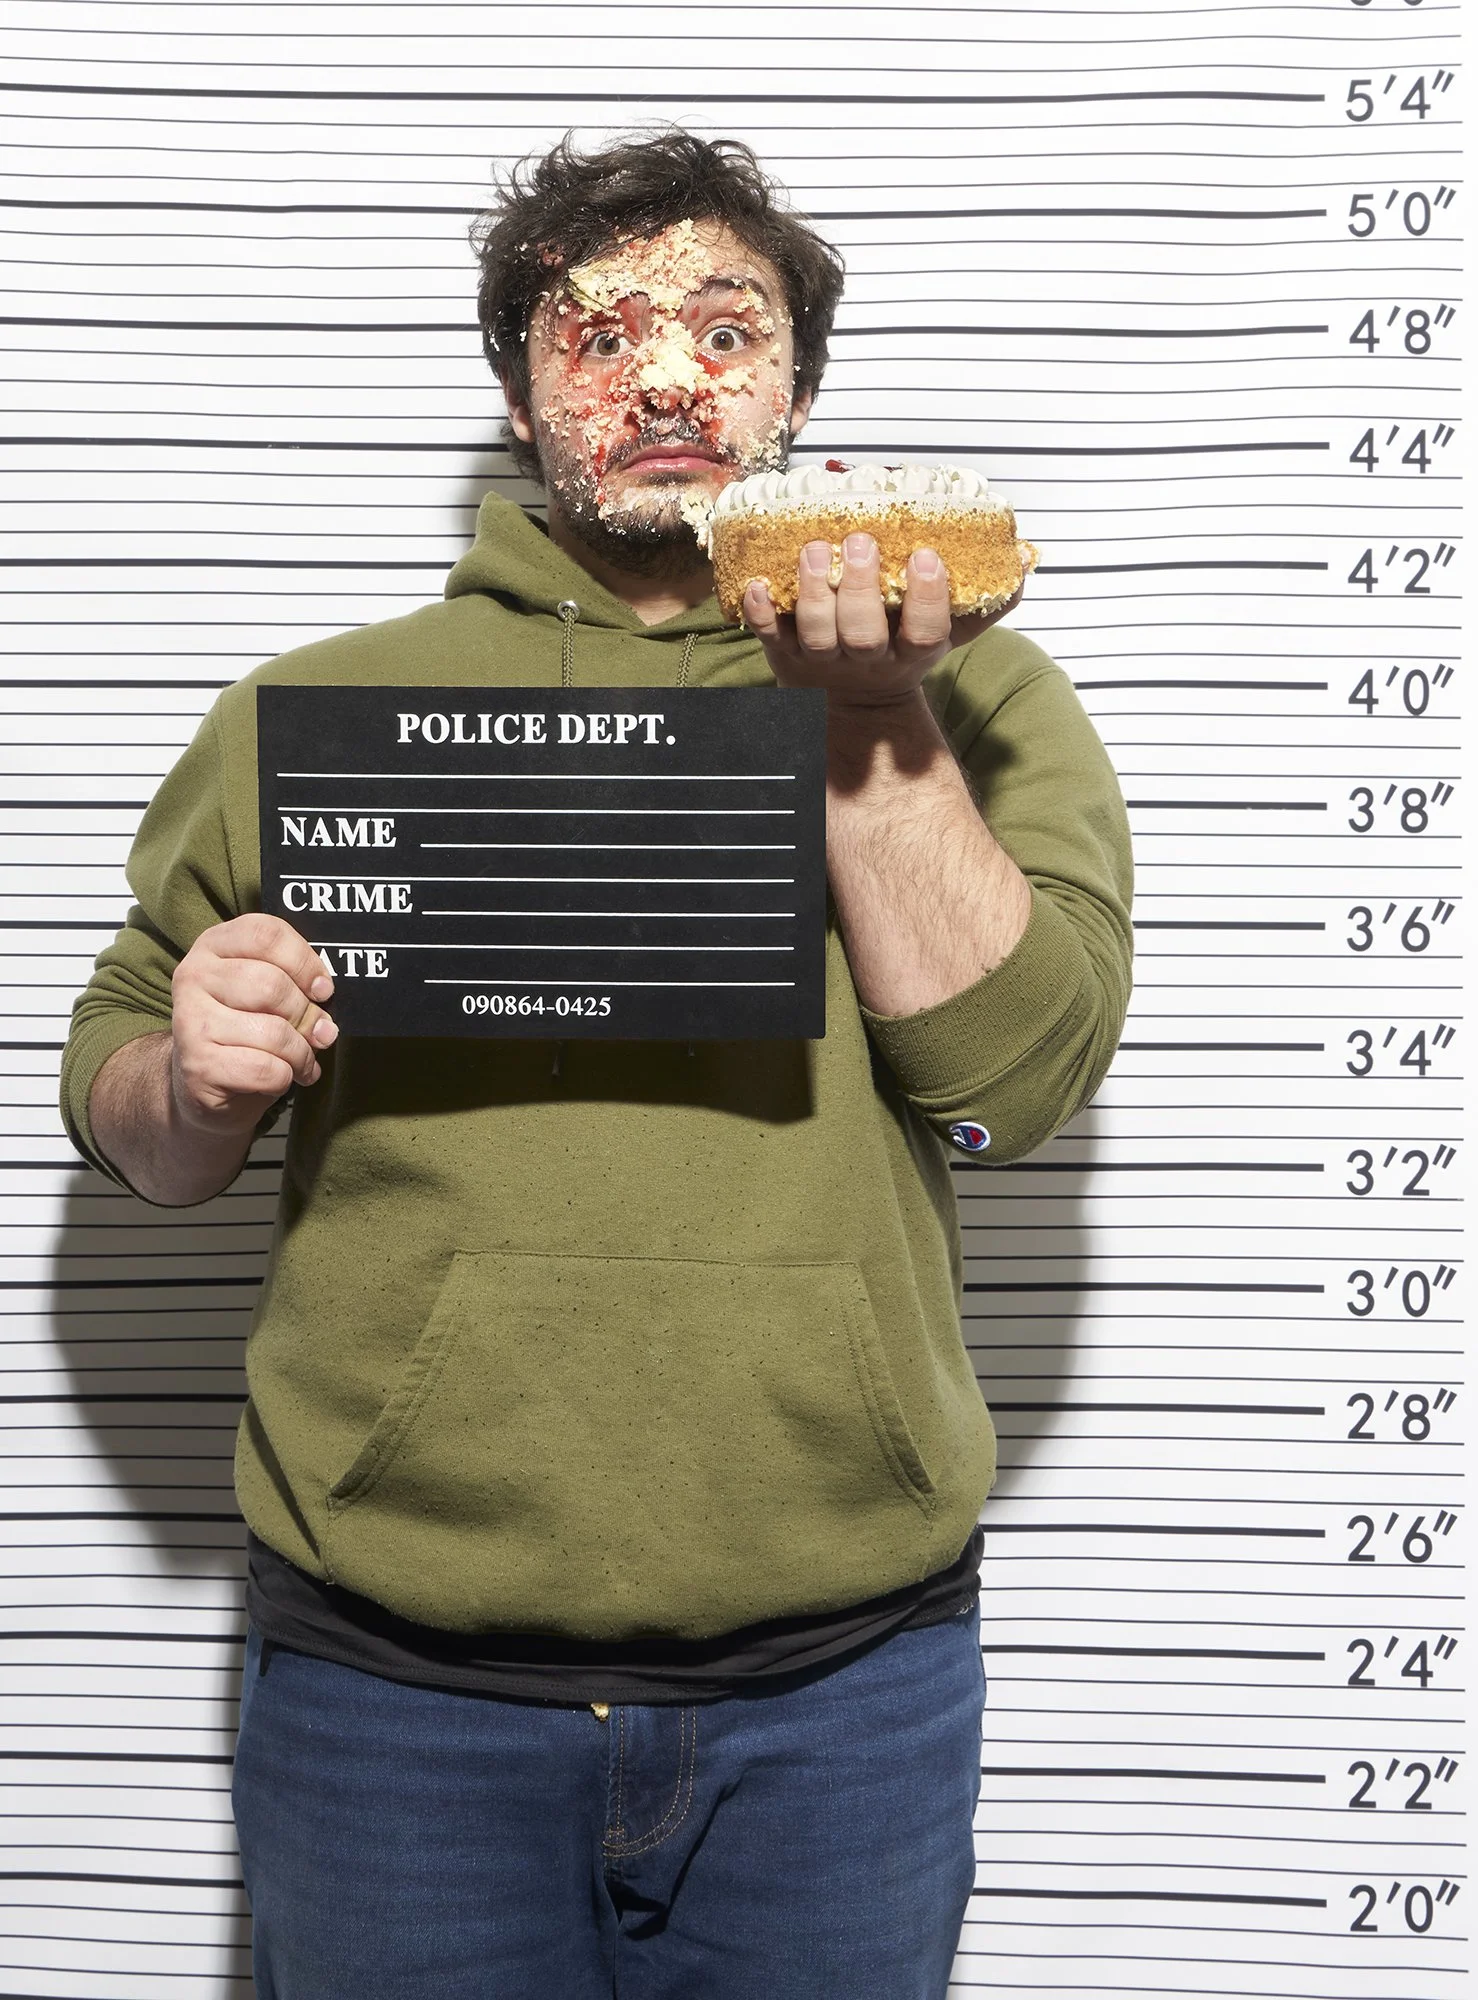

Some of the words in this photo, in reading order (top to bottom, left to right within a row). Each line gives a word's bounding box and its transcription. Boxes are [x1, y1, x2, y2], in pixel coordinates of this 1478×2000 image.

[1345, 69, 1455, 122] 5'4"
[1347, 185, 1456, 238] 5'0"
[1349, 303, 1456, 355] 4'8"
[1349, 423, 1456, 474] 4'4"
[1347, 542, 1457, 594] 4'2"
[1348, 663, 1455, 715] 4'0"
[396, 712, 548, 745] POLICE
[557, 713, 677, 746] DEPT.
[280, 816, 397, 848] NAME
[1348, 781, 1455, 834] 3'8"
[282, 881, 414, 914] CRIME
[1346, 899, 1455, 953] 3'6"
[318, 947, 390, 978] ATE
[461, 994, 612, 1018] 090864-0425
[1346, 1023, 1457, 1077] 3'4"
[1346, 1143, 1457, 1197] 3'2"
[1347, 1264, 1457, 1318] 3'0"
[1346, 1387, 1458, 1441] 2'8"
[1347, 1509, 1458, 1564] 2'6"
[1347, 1634, 1458, 1688] 2'4"
[1347, 1756, 1459, 1810] 2'2"
[1348, 1879, 1461, 1934] 2'0"
